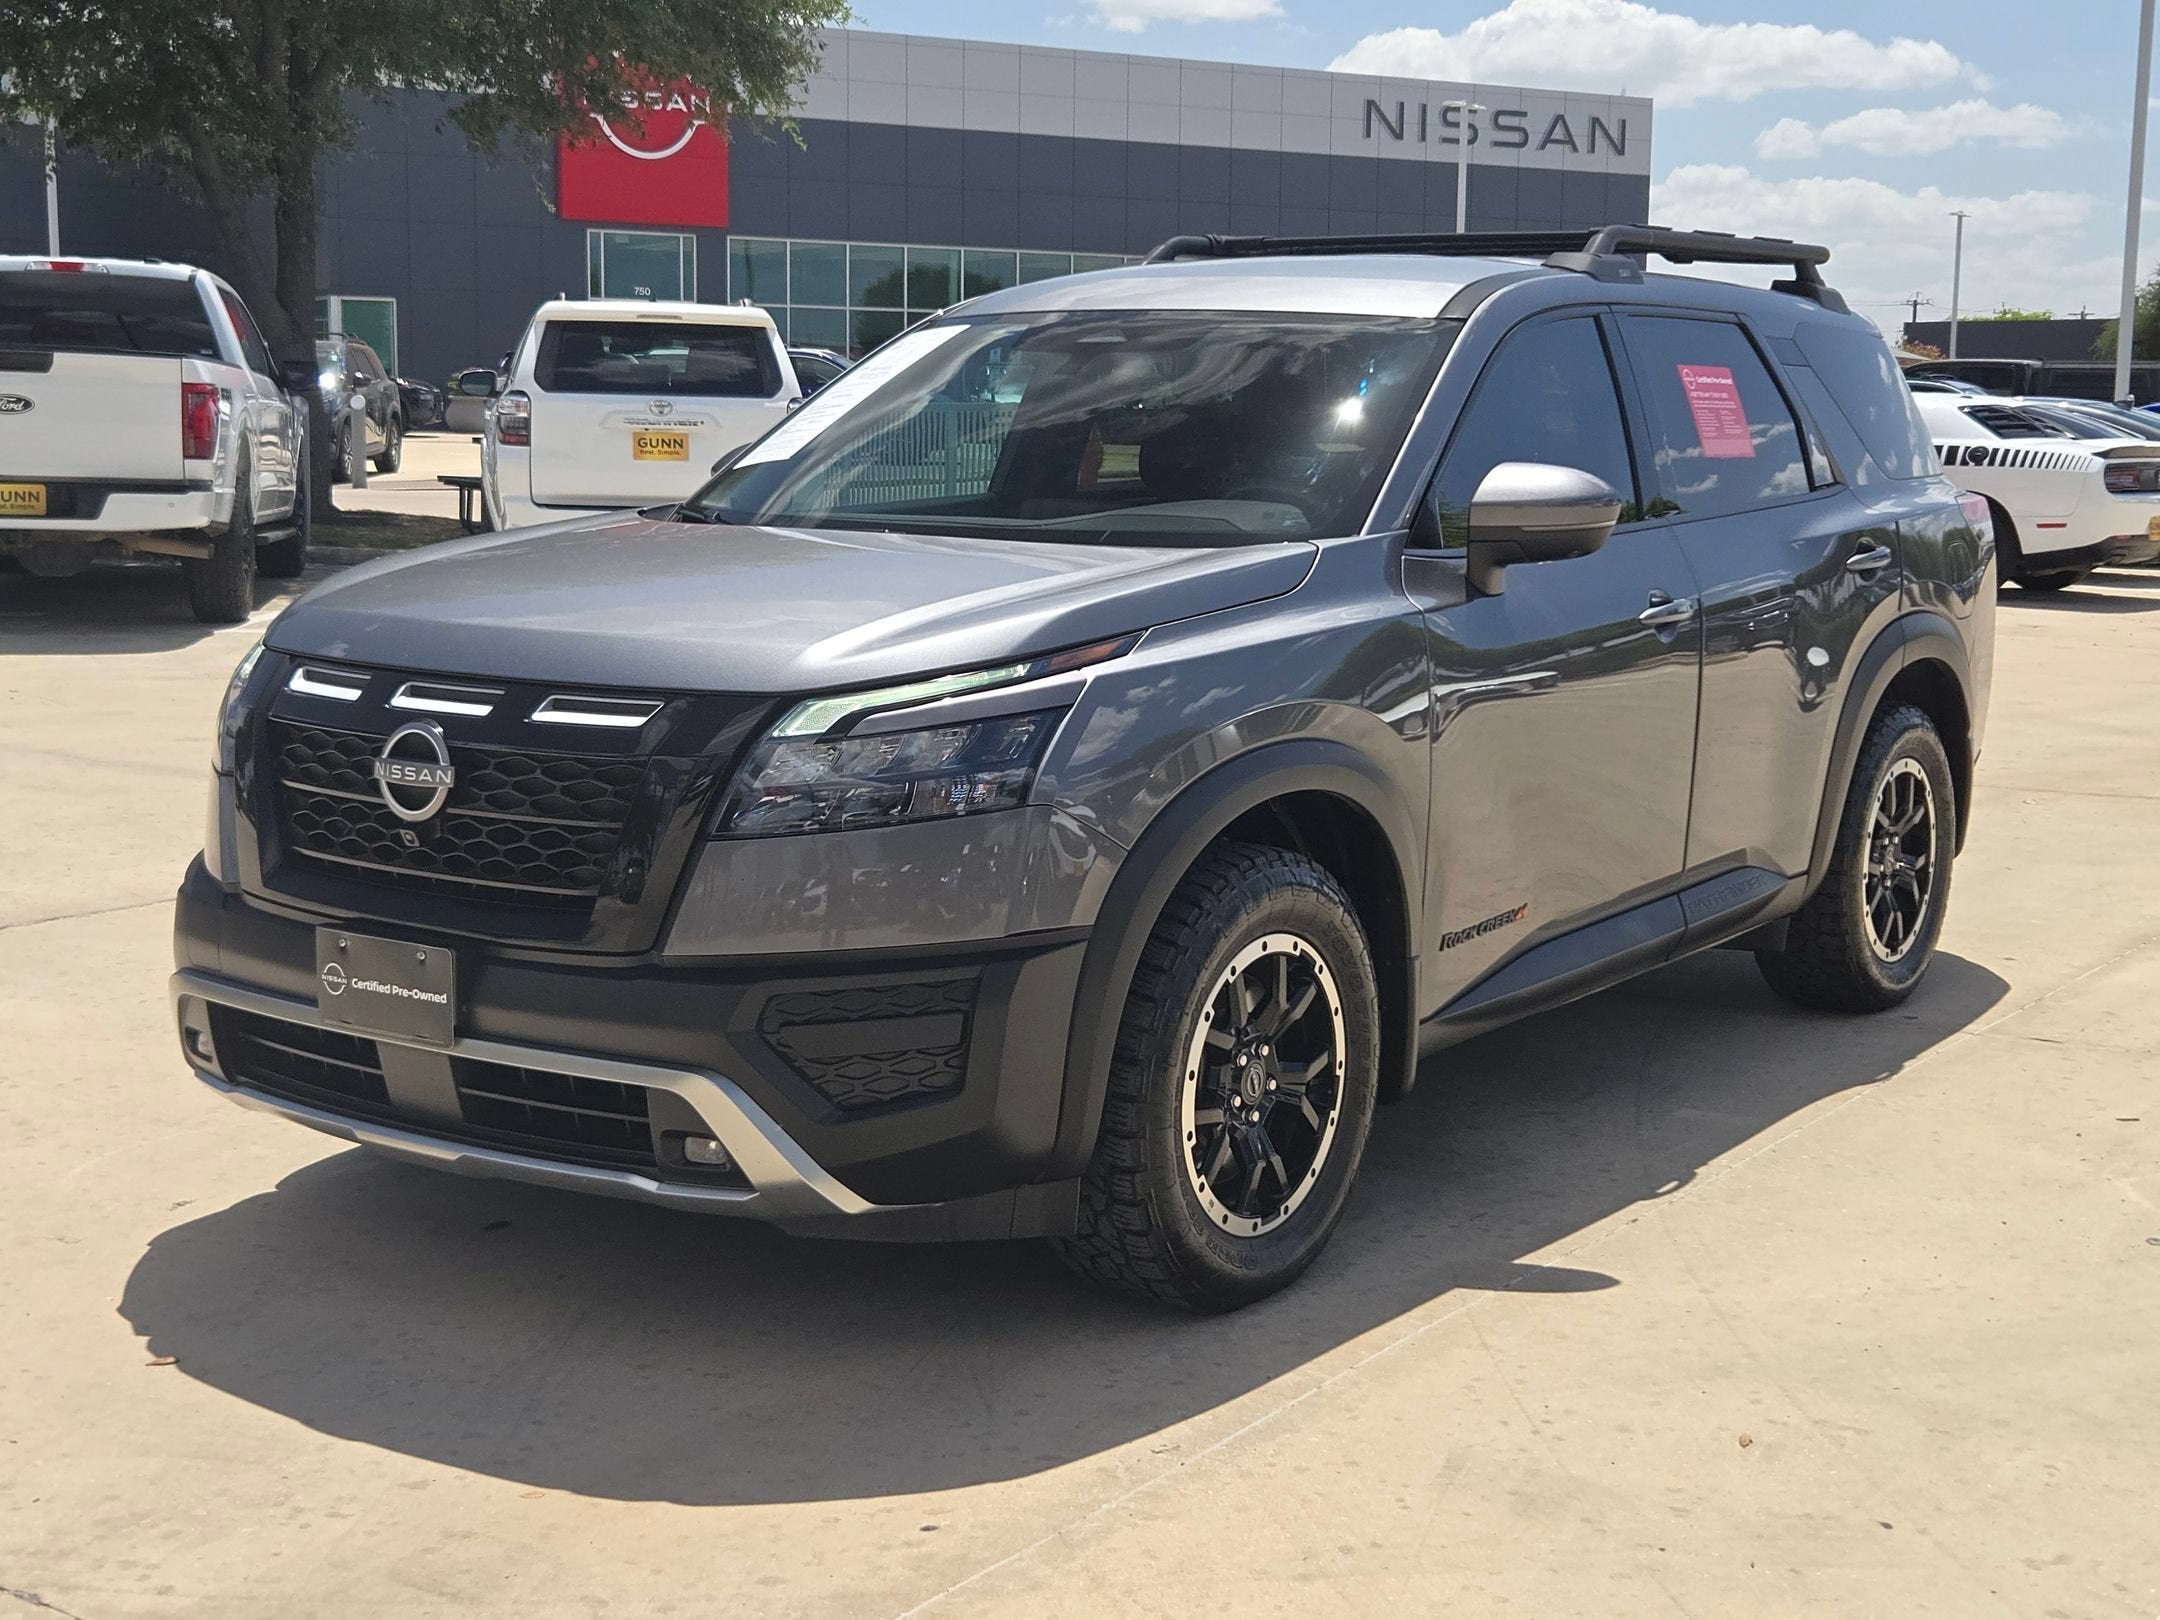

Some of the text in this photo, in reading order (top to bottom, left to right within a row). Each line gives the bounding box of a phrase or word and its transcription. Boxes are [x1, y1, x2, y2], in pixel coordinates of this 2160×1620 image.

[583, 88, 712, 114] SSAN
[1363, 99, 1627, 156] NISSAN
[634, 286, 651, 296] 750
[637, 437, 684, 449] GUNN
[0, 490, 40, 503] UNN
[375, 760, 452, 784] NISSAN
[1438, 924, 1477, 952] ROCK
[321, 974, 348, 985] NISSAN
[351, 978, 448, 1004] Certified Pre-Owned
